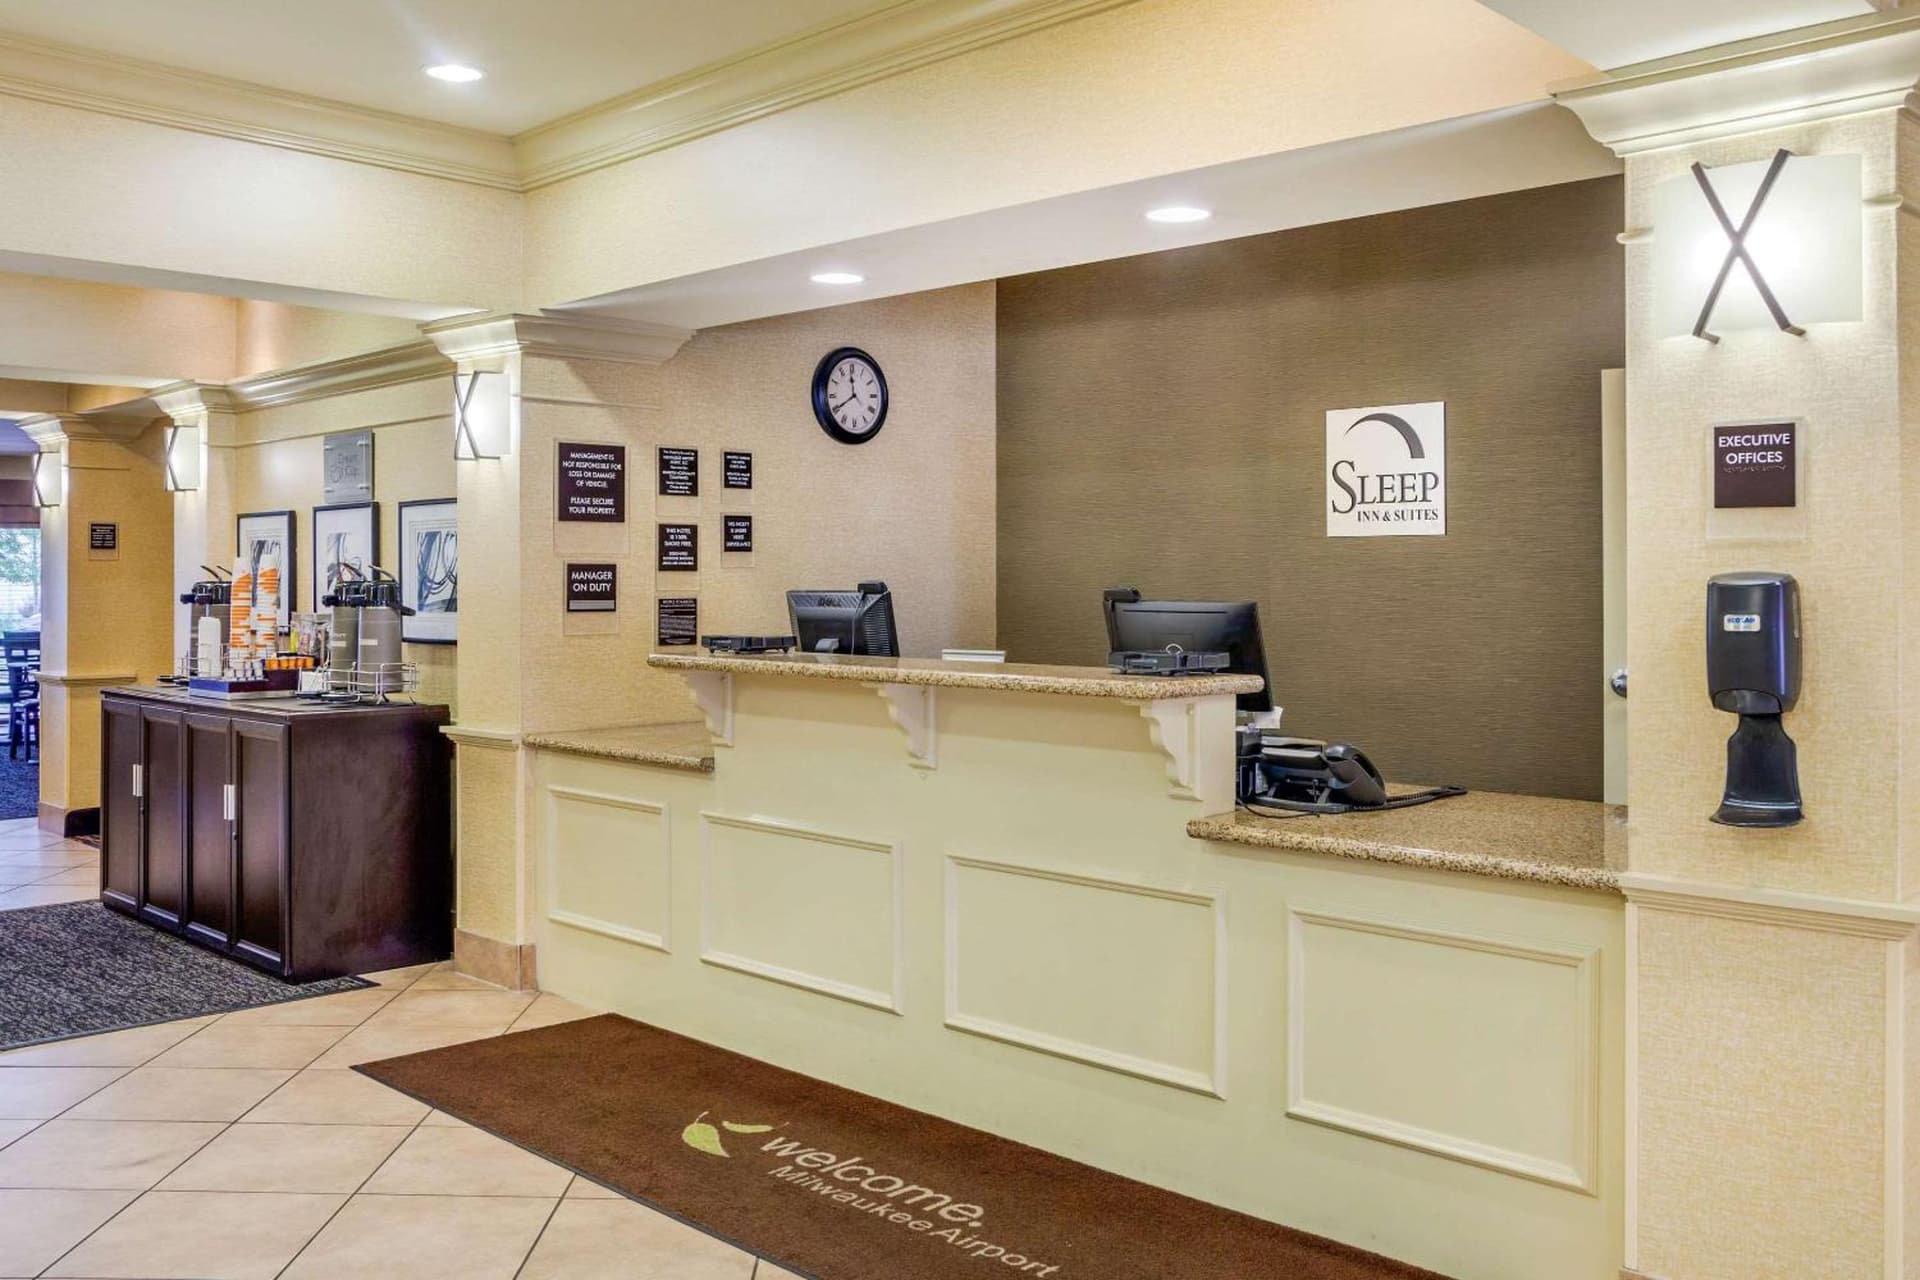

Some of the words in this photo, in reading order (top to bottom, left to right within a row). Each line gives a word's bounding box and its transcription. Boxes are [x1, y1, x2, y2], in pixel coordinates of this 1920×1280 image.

[1718, 433, 1791, 448] EXECUTIVE
[1725, 451, 1783, 464] OFFICES
[611, 463, 622, 471] FOR
[1332, 460, 1440, 514] SLEEP
[570, 497, 591, 505] PLEASE
[592, 497, 614, 505] SECURE
[568, 506, 586, 514] YOUR
[1357, 511, 1381, 522] INN
[1382, 511, 1391, 522] &
[1394, 508, 1439, 521] SUITES
[571, 570, 613, 580] MANAGER
[572, 583, 587, 592] ON
[589, 583, 611, 592] DUTY
[768, 1165, 932, 1232] Milwaukee
[931, 1227, 1062, 1279] Airport
